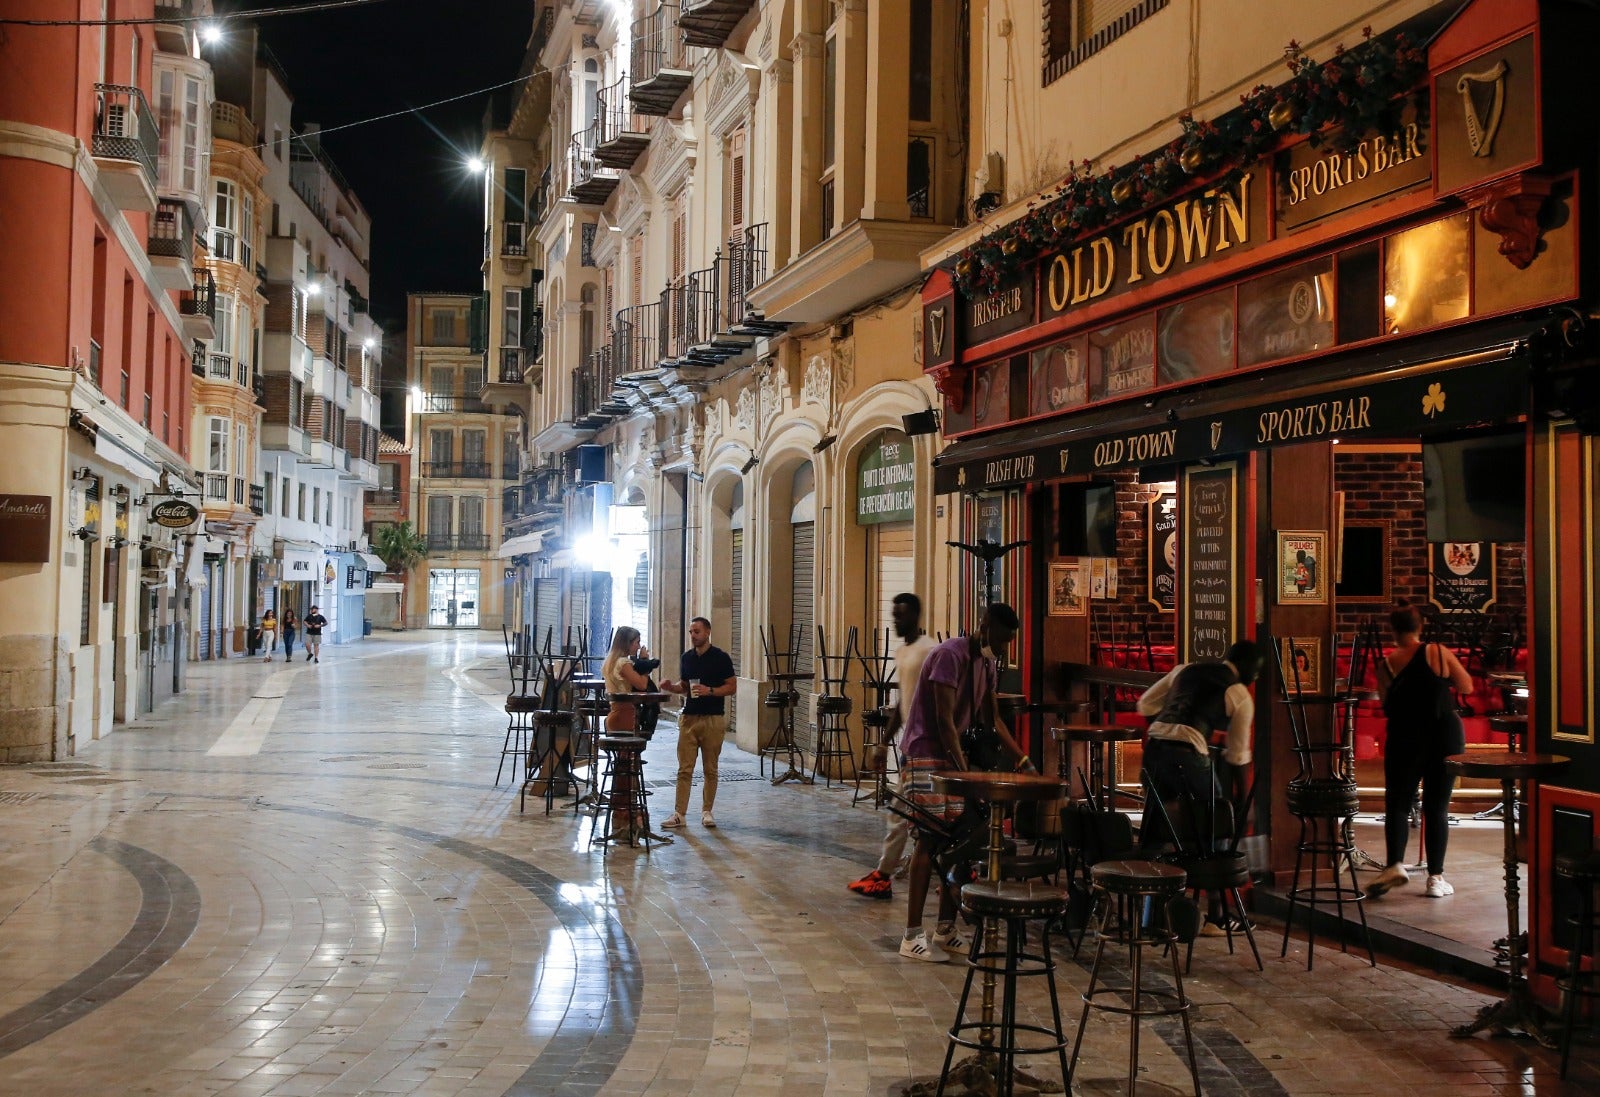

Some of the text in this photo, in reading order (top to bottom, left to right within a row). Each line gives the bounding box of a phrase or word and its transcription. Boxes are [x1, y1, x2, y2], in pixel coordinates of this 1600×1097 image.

[1289, 122, 1422, 205] SPORTS BAR
[1048, 173, 1251, 312] OLD TOWN
[973, 287, 1021, 327] IRISH PUB
[1257, 396, 1371, 443] SPORTS BAR
[1094, 429, 1177, 467] OLD TOWN
[863, 469, 878, 488] PUNTO
[878, 467, 885, 485] DE
[985, 455, 1035, 484] IRISH PUB
[860, 497, 866, 515] DE
[895, 491, 903, 510] DE
